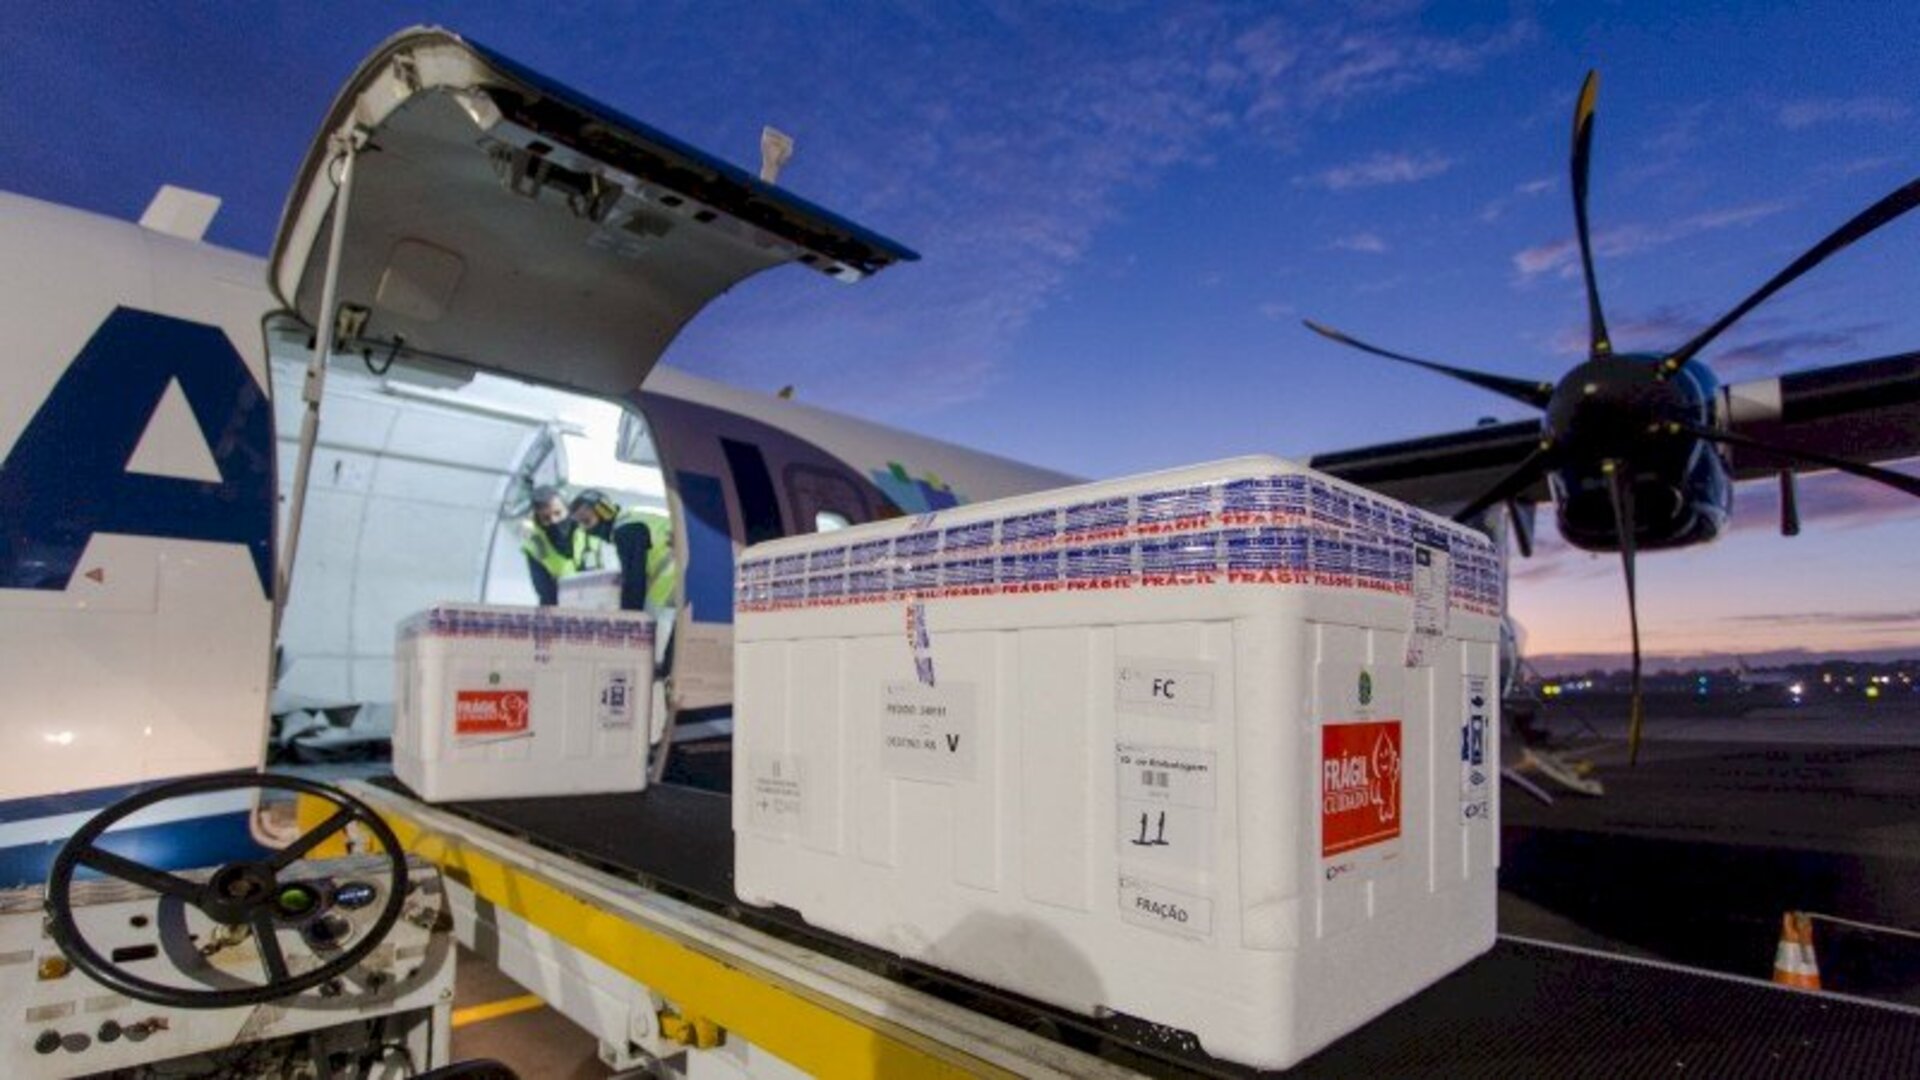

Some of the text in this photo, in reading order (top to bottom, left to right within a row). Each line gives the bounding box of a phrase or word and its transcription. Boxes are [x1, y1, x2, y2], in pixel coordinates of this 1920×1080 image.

[0, 304, 274, 601] A
[1153, 678, 1175, 699] FC
[1324, 749, 1369, 791] FRÁGIL
[1136, 897, 1189, 922] FRAÇÃO
